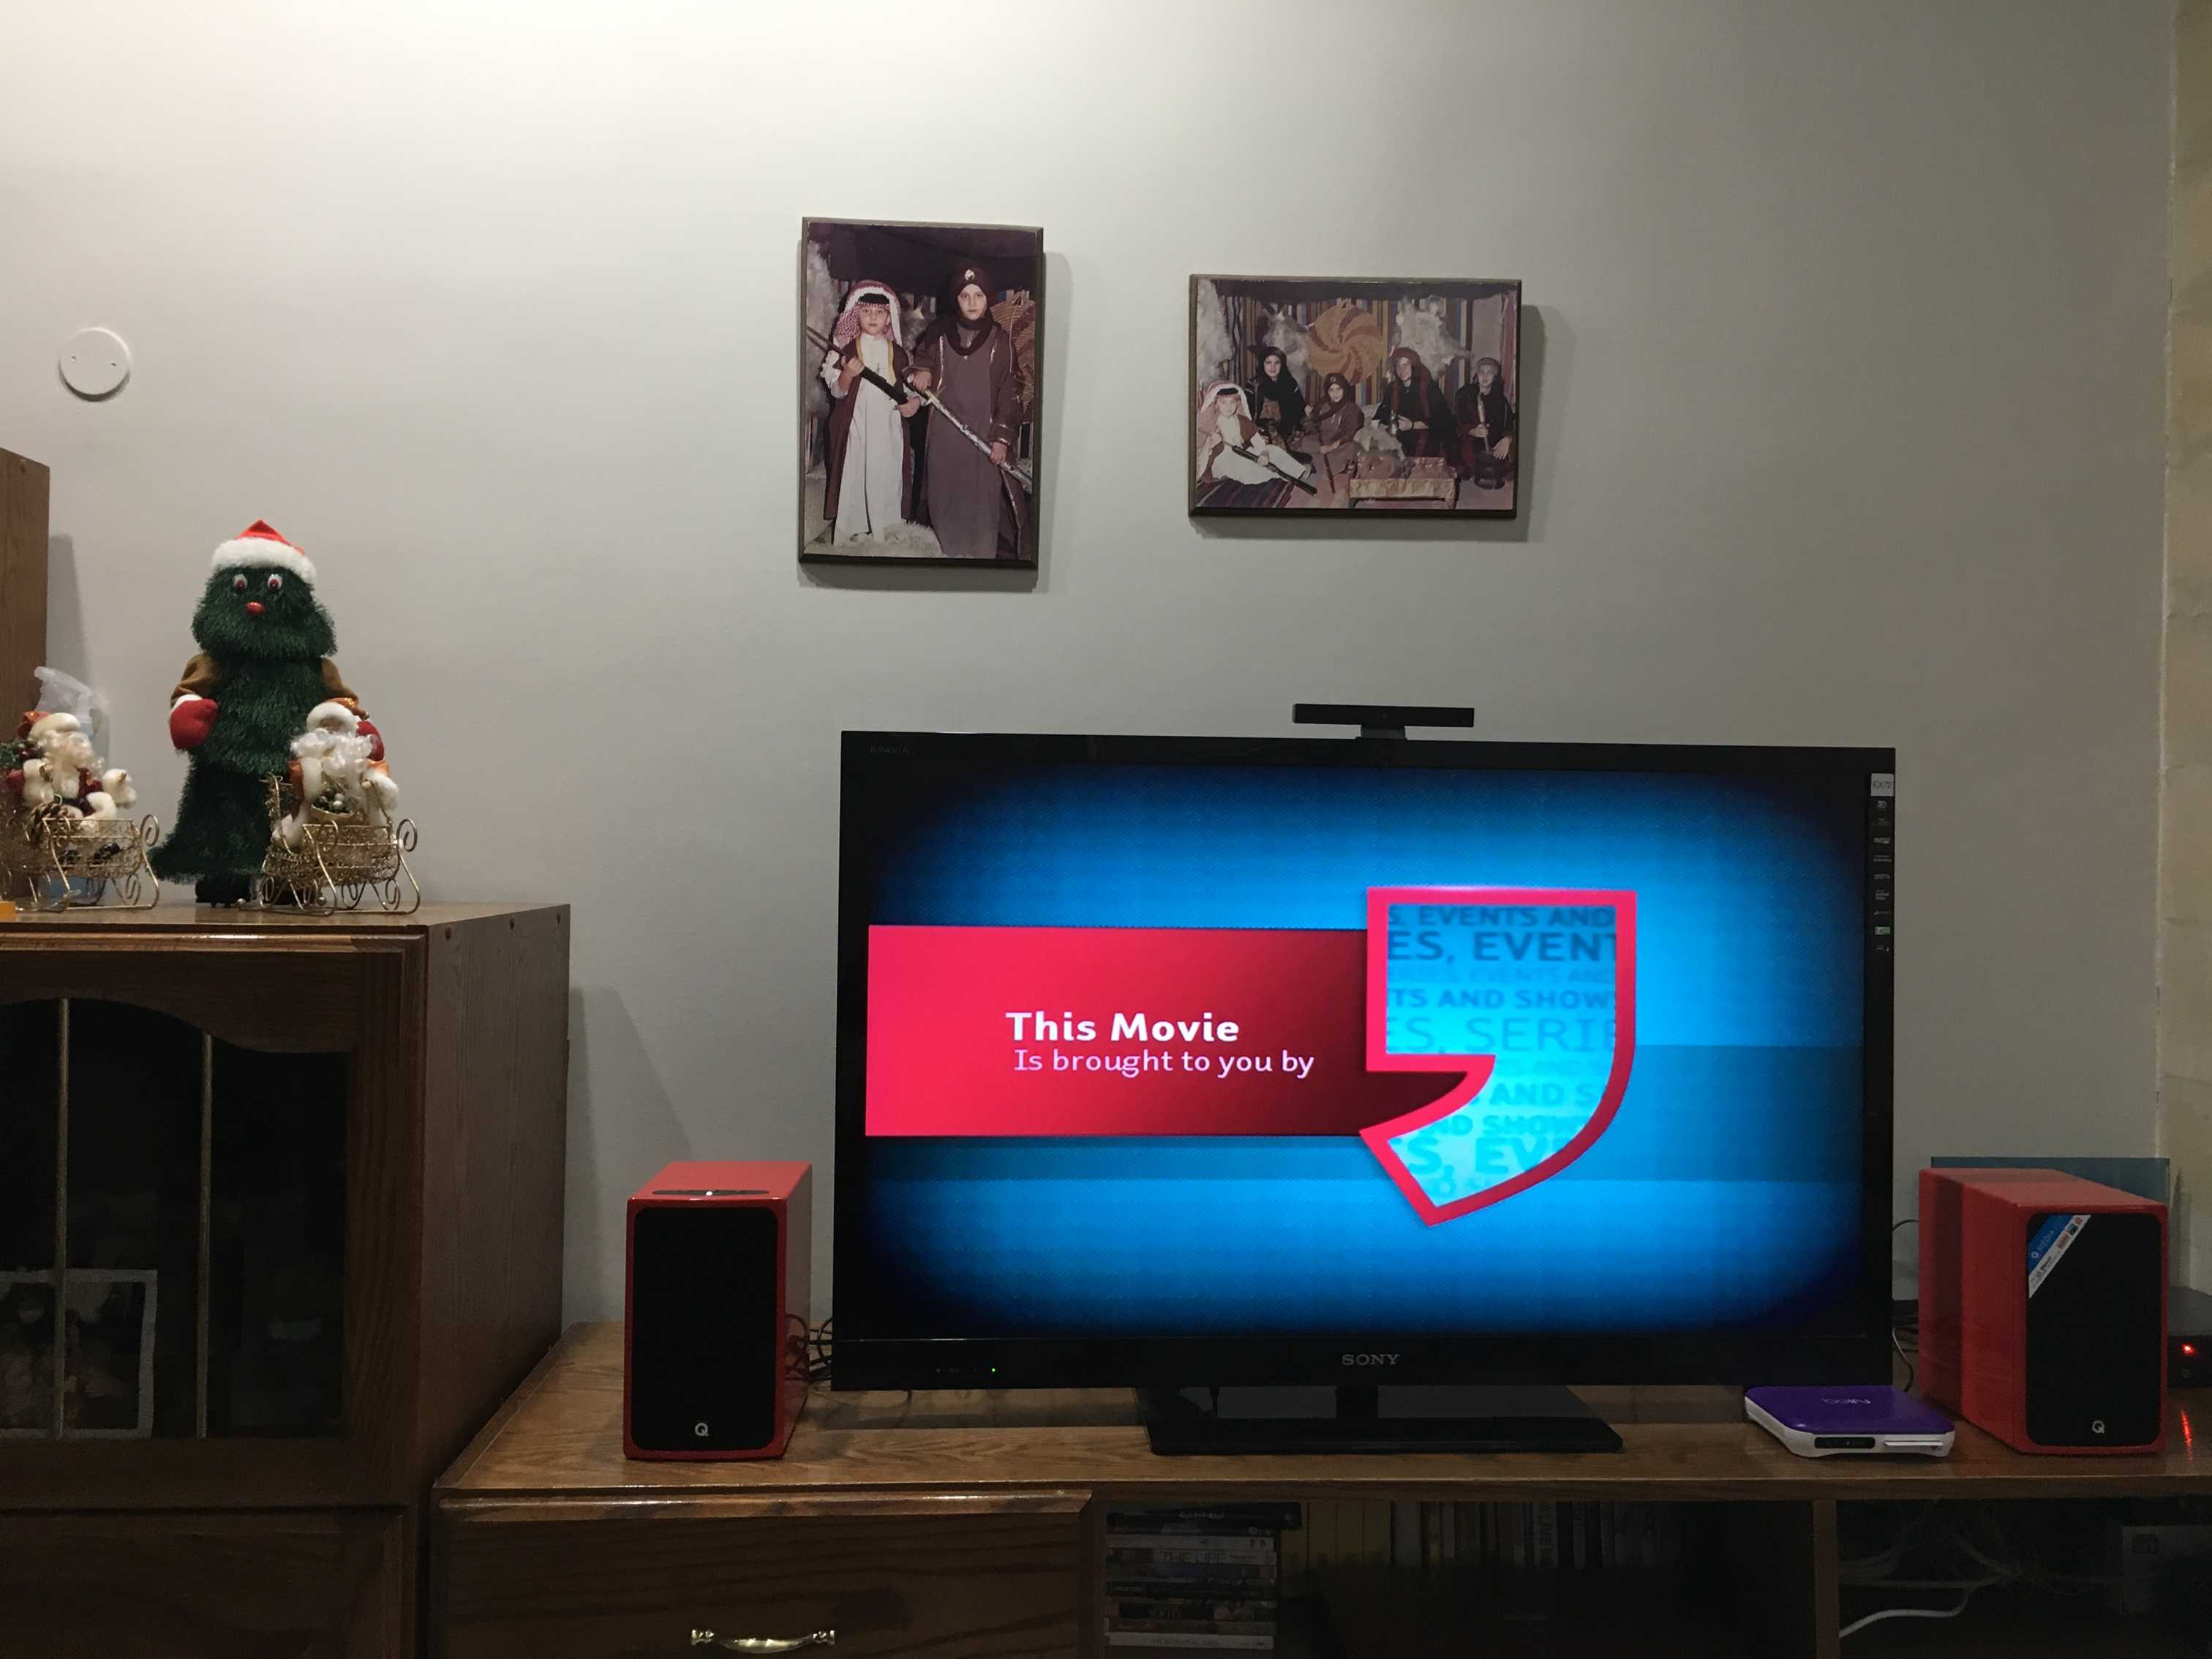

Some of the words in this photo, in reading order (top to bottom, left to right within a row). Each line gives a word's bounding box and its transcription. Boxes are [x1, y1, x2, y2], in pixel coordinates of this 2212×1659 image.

[1419, 906, 1540, 927] EVENTS
[1548, 908, 1615, 928] AND
[1437, 989, 1505, 1009] AND
[1516, 990, 1614, 1009] SHOW
[1005, 1011, 1096, 1042] This
[1110, 1012, 1239, 1042] Movie
[1014, 1050, 1043, 1071] Is
[1053, 1050, 1173, 1078] brought
[1181, 1051, 1210, 1072] to
[1217, 1056, 1272, 1078] you
[1282, 1050, 1314, 1079] by
[1489, 1083, 1563, 1106] AND
[1342, 1353, 1400, 1365] SONY
[695, 1422, 709, 1437] Q
[2092, 1420, 2105, 1434] Q
